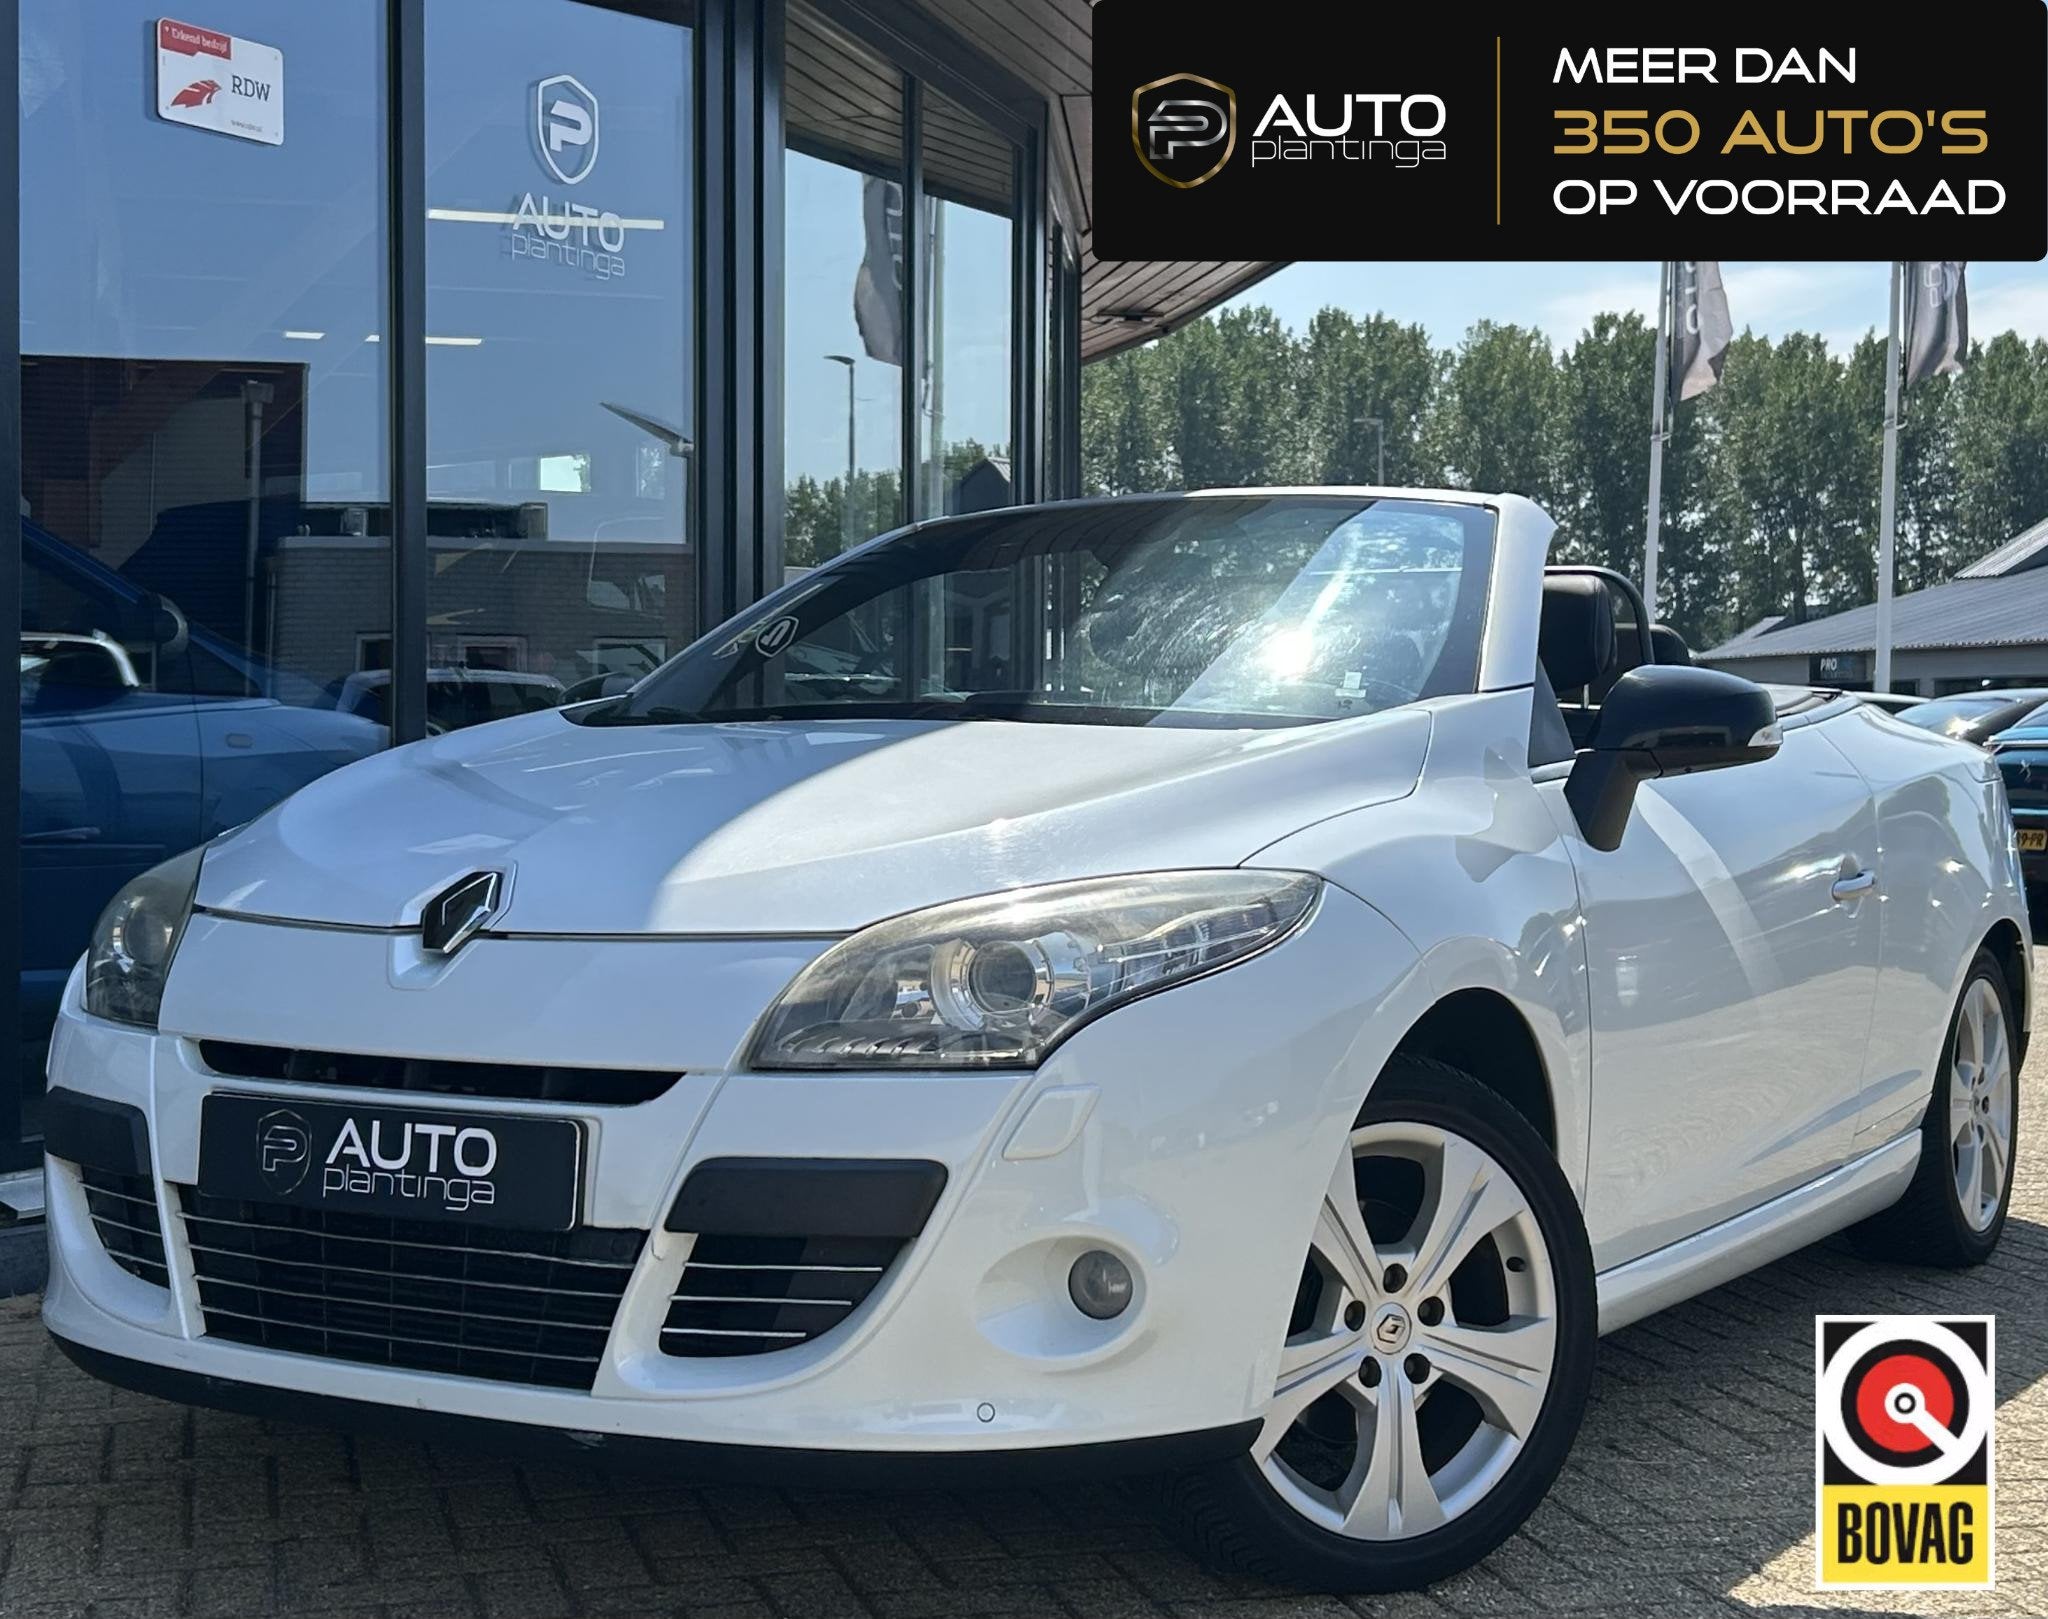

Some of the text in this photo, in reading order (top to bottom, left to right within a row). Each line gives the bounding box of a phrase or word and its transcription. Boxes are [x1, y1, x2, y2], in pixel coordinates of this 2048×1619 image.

[231, 75, 271, 102] RDW
[512, 192, 625, 253] AUTO
[511, 233, 625, 280] plantinga
[1820, 657, 1838, 672] PRO
[325, 1117, 498, 1177] AUTO
[322, 1165, 495, 1212] plantinga
